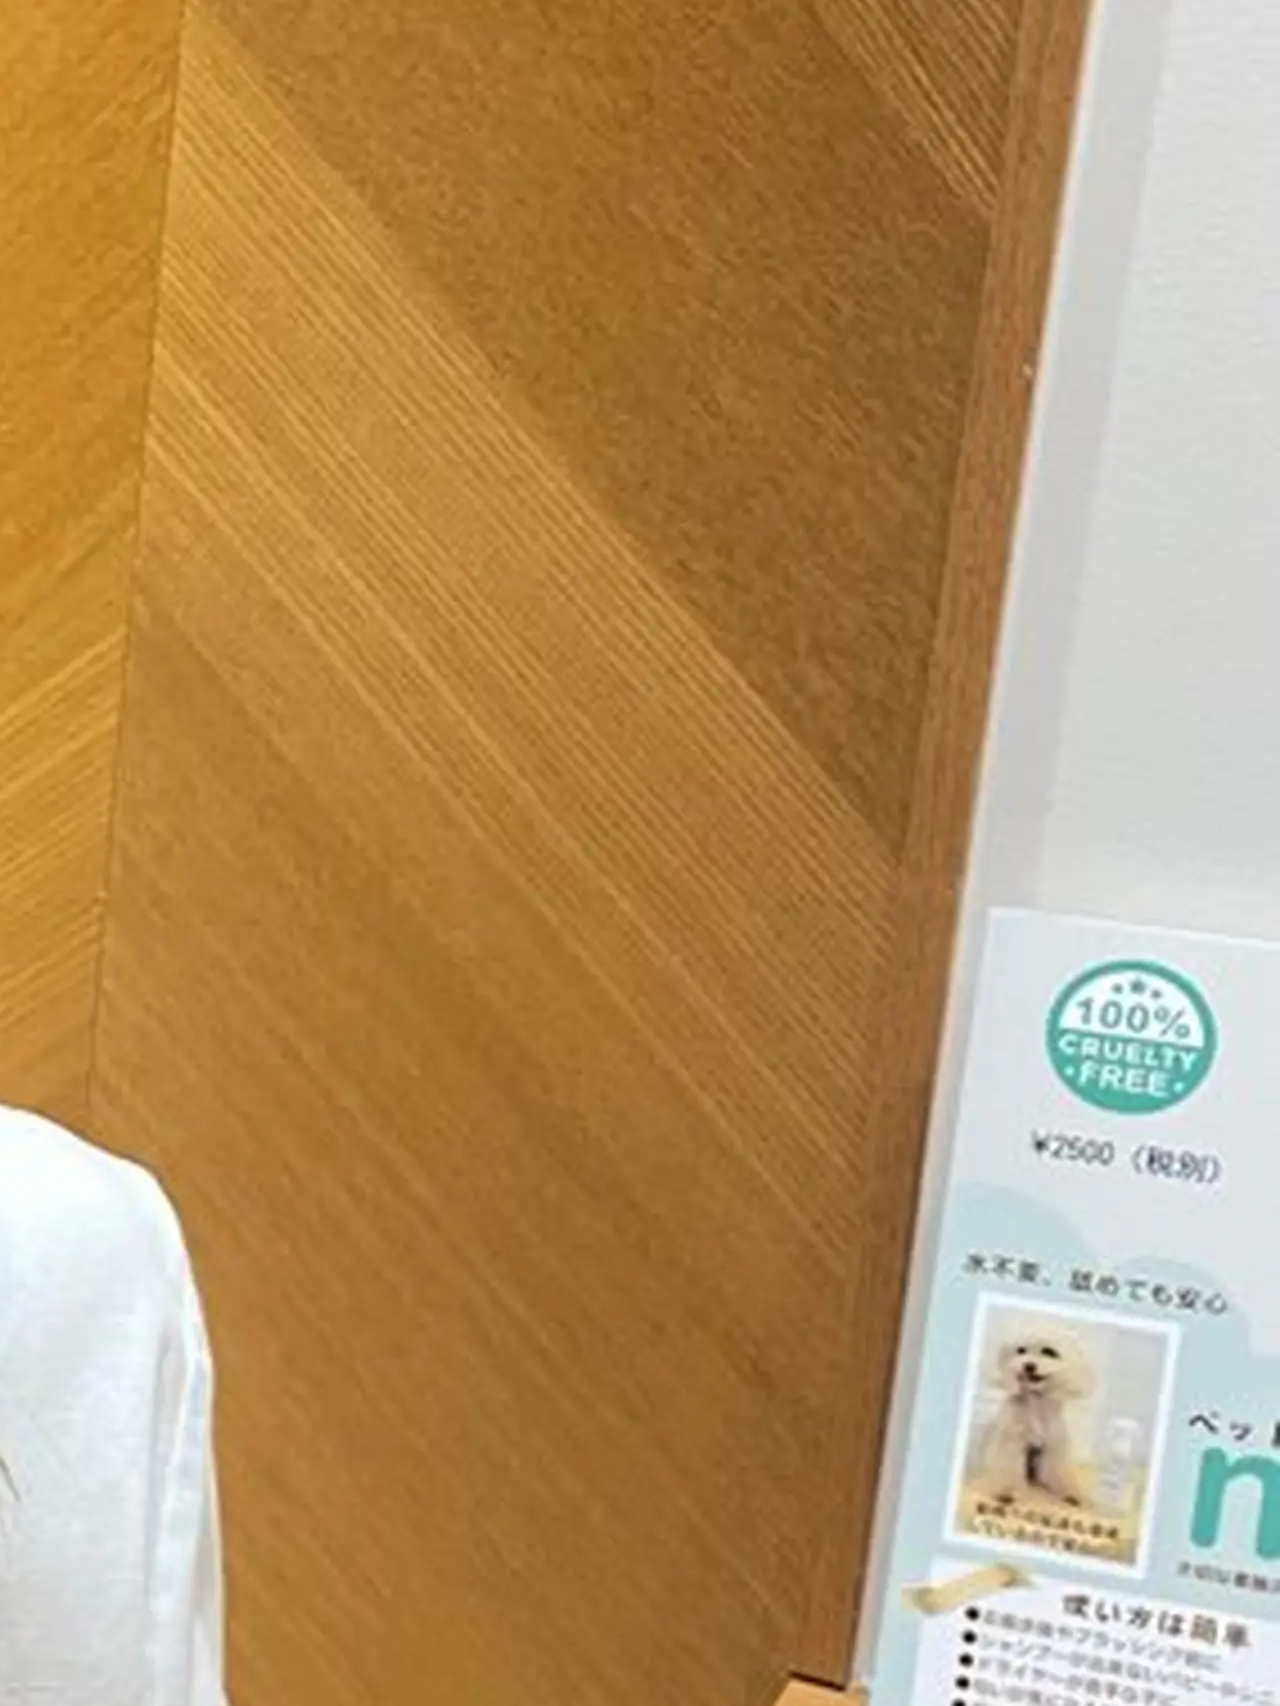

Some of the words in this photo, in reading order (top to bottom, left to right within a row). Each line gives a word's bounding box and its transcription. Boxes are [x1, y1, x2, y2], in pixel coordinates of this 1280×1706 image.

[1076, 997, 1190, 1040] 100%
[1058, 1033, 1201, 1072] CRUELTY
[1078, 1062, 1171, 1098] FREE
[1063, 1595, 1250, 1647] 使い方は簡単
